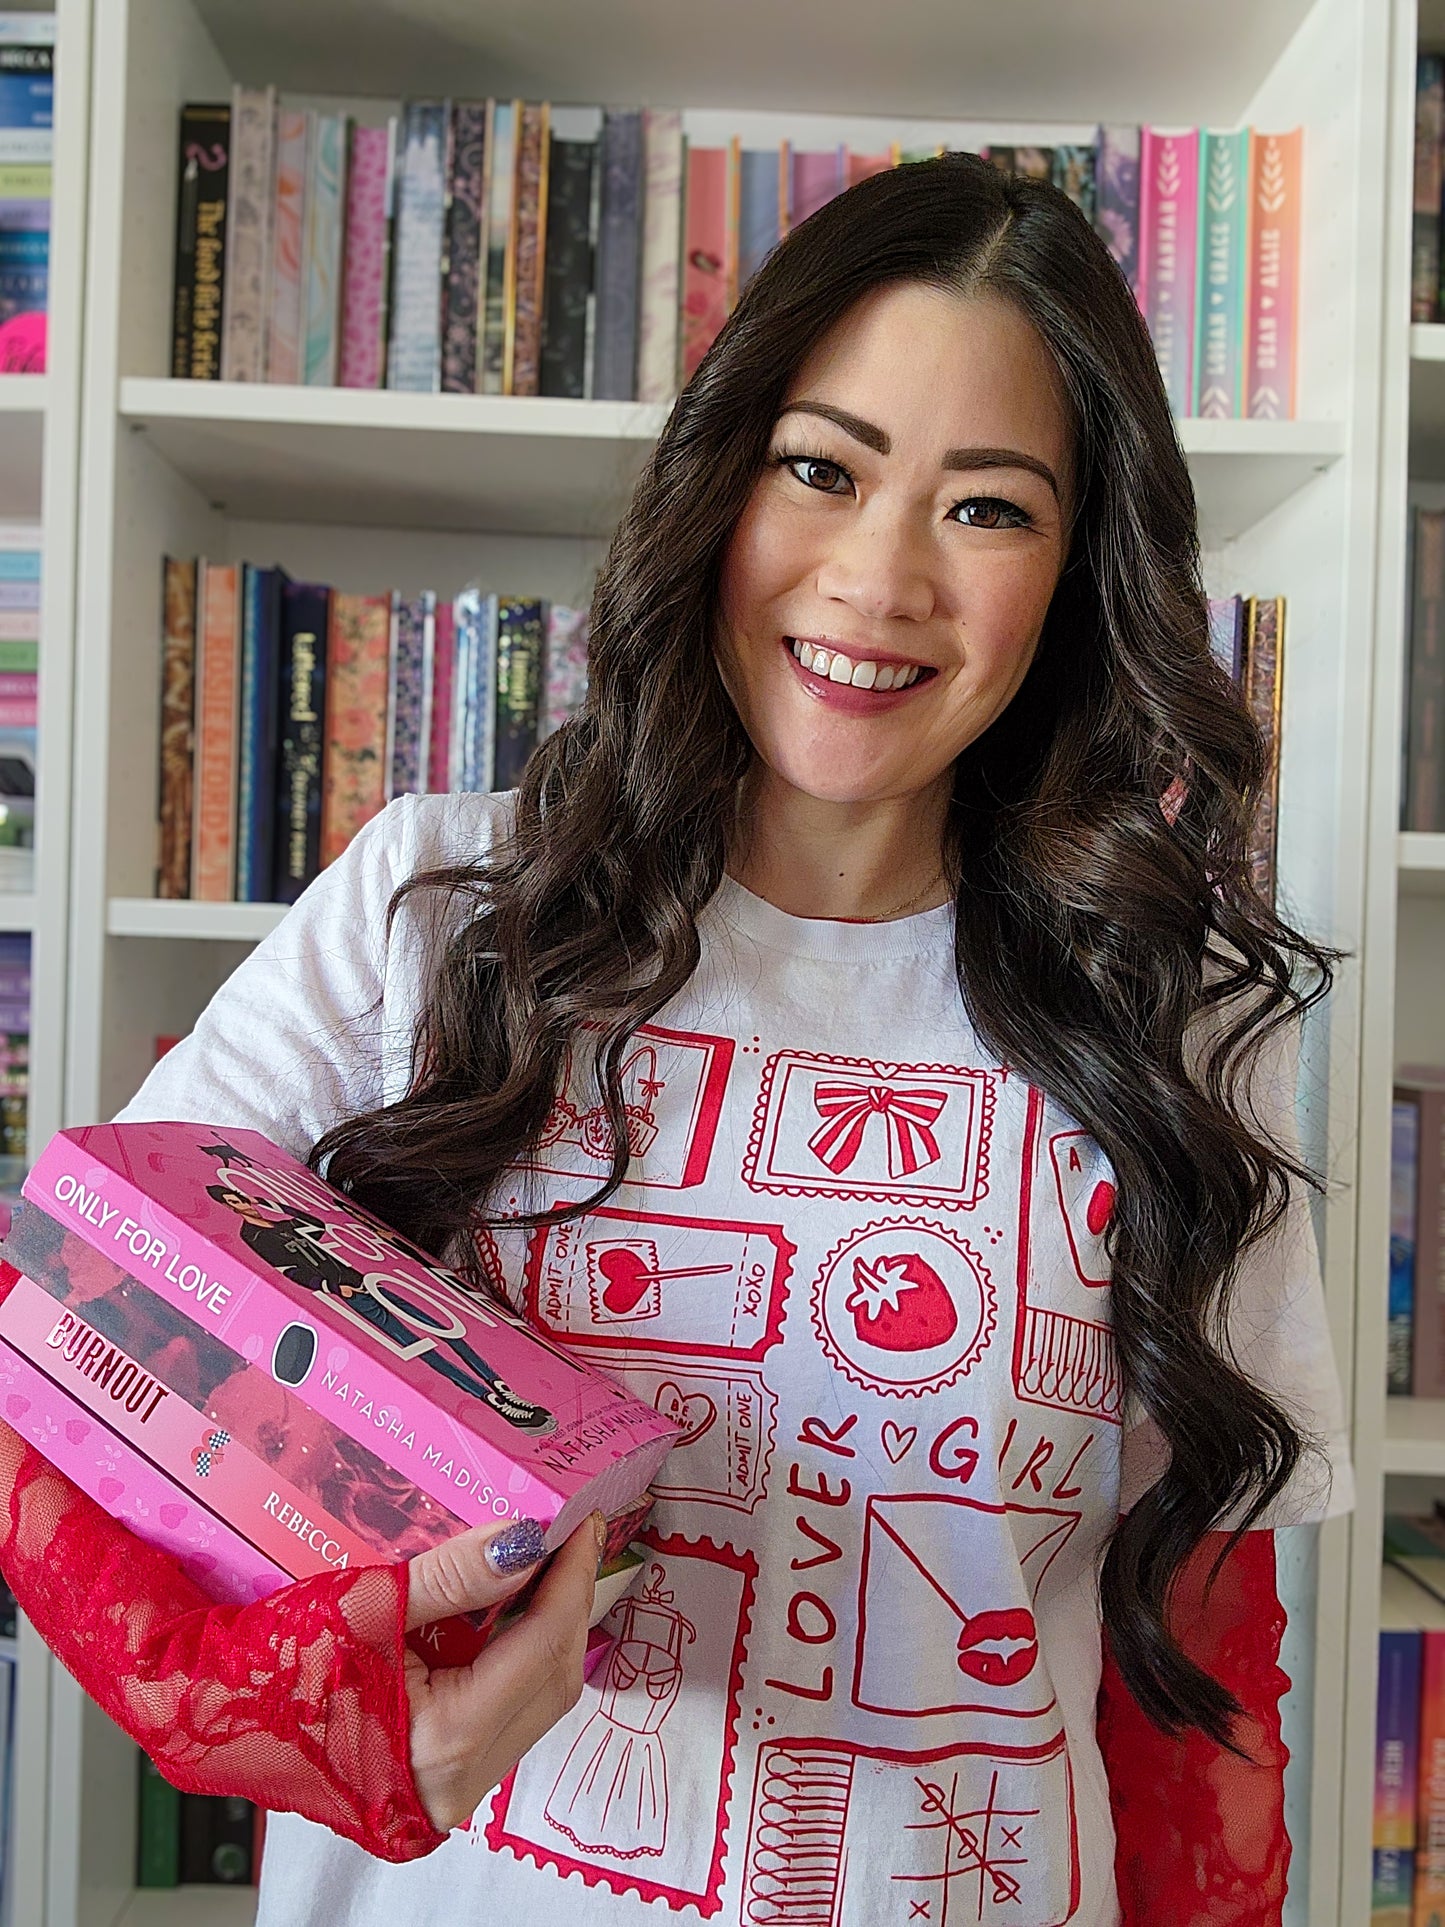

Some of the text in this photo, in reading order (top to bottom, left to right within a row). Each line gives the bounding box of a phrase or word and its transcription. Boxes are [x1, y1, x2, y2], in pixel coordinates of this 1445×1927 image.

[1157, 201, 1177, 283] HANNAH
[1206, 222, 1230, 375] LOGAN GRACE
[1257, 229, 1281, 369] DEAN ALLIE
[54, 1174, 232, 1315] ONLY FOR LOVE
[294, 1217, 412, 1268] FOR
[546, 1224, 574, 1321] ADMIT ONE
[312, 1266, 527, 1362] LOVE
[45, 1312, 170, 1424] BURNOUT
[321, 1370, 417, 1450] NATASHA
[671, 1398, 689, 1416] BE
[542, 1421, 620, 1474] NATASHA
[735, 1391, 752, 1487] ADMIT ONE
[262, 1491, 349, 1570] REBECCA
[765, 1414, 1094, 1701] LOVER GIRL
